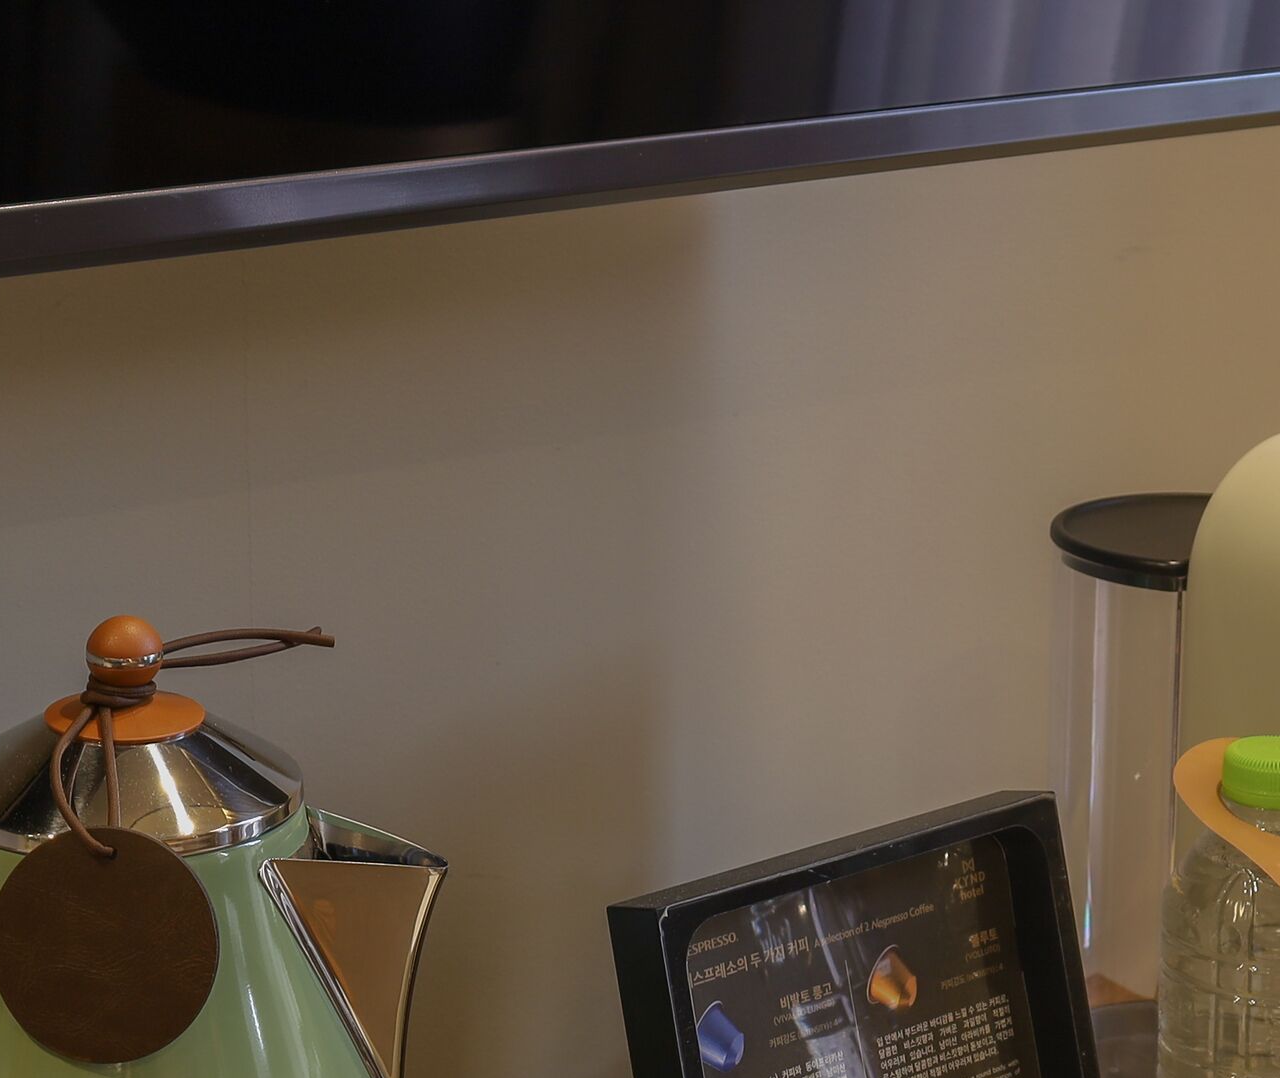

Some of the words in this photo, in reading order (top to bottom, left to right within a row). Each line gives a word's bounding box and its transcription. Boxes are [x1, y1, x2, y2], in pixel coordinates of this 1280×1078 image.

[822, 928, 855, 946] election
[871, 911, 908, 930] Nespresso
[908, 903, 934, 918] Coffee
[750, 952, 762, 968] 두
[787, 936, 809, 956] 커피
